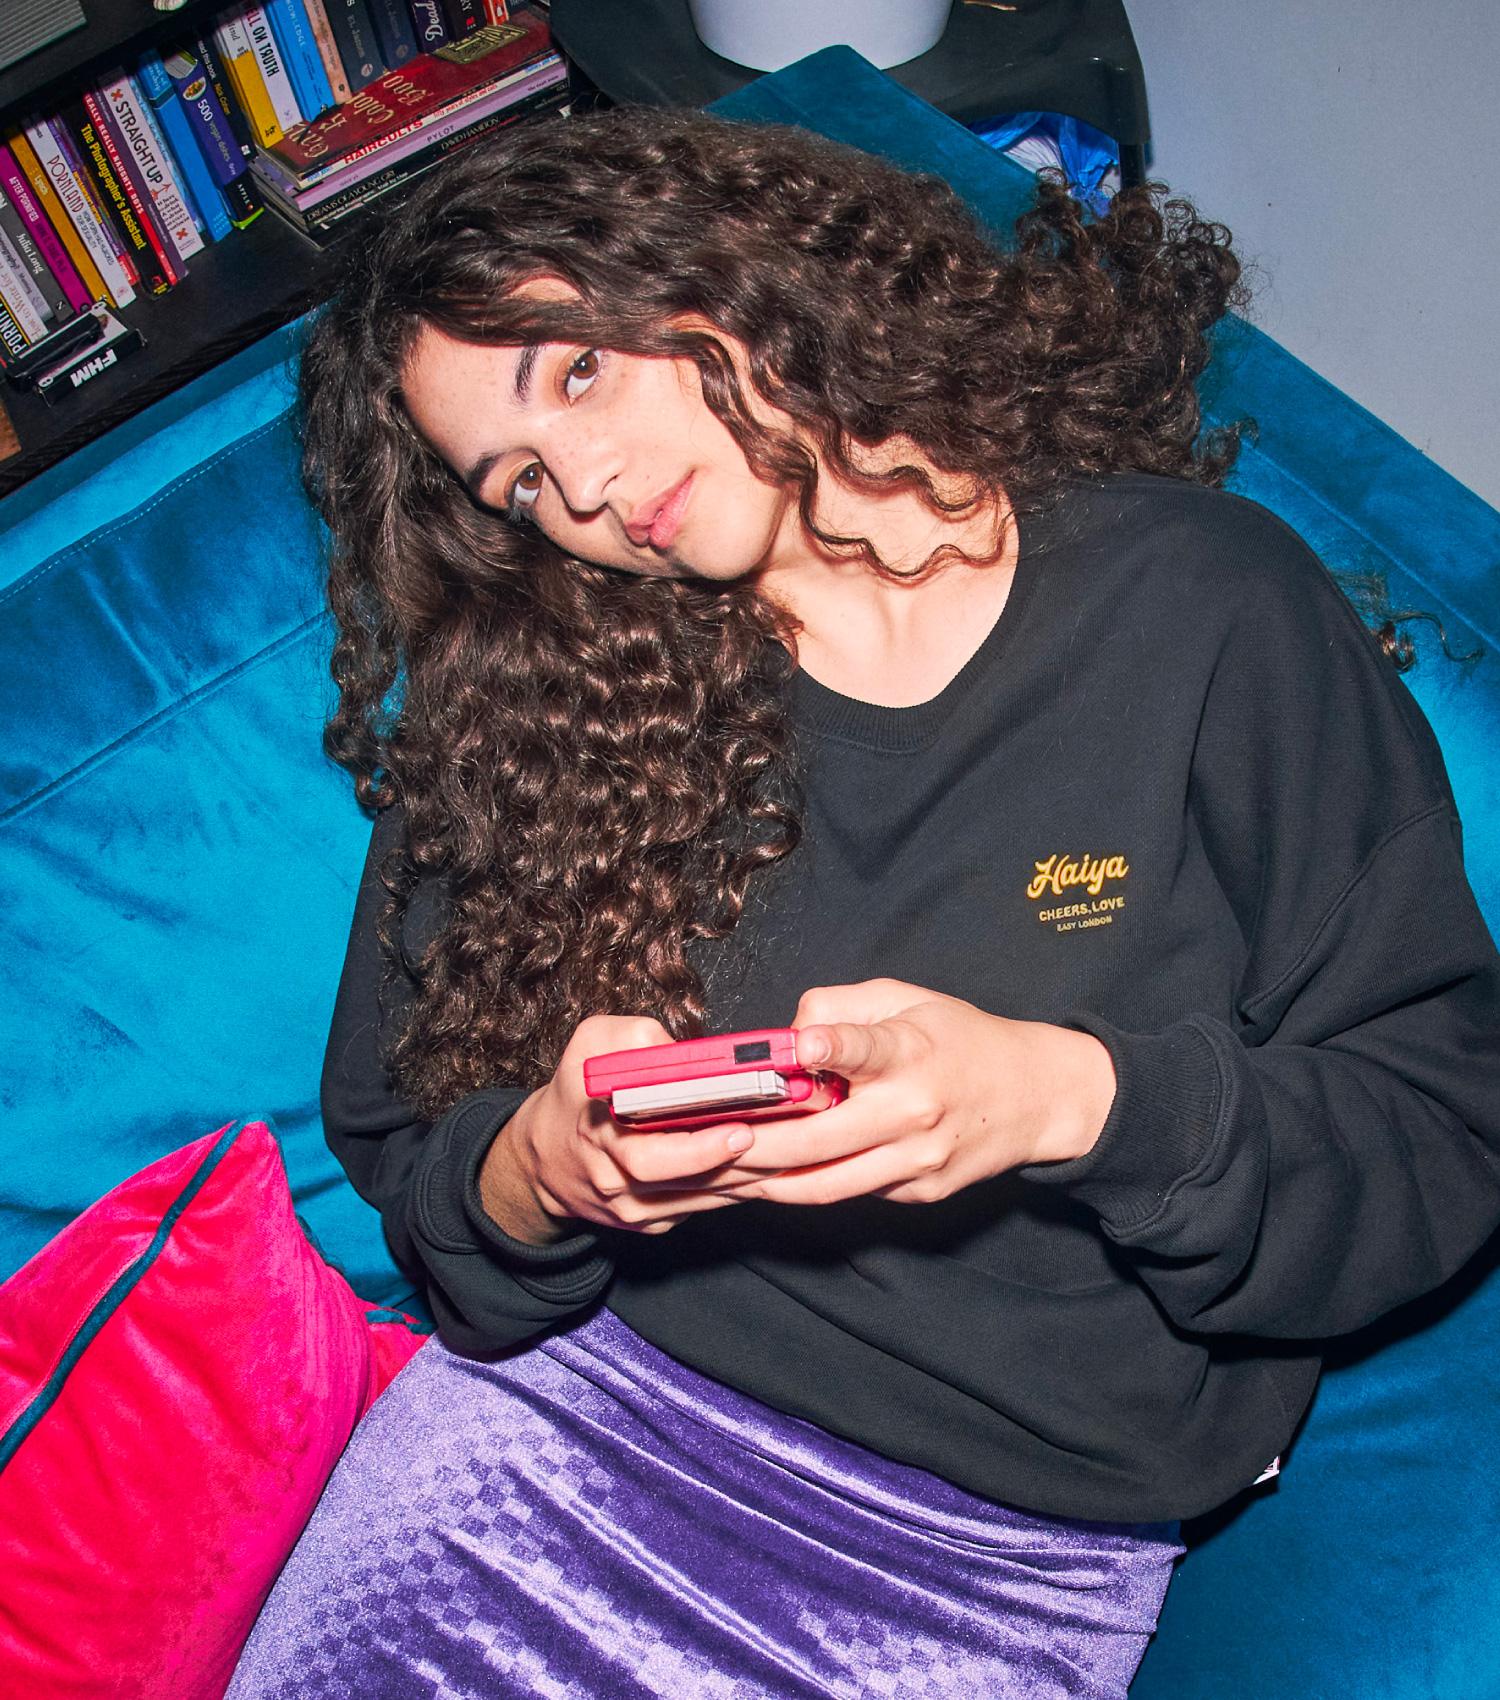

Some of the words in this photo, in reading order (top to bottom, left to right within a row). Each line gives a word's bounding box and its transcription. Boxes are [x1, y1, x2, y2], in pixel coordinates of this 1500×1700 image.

[80, 124, 96, 143] The
[112, 100, 158, 168] STRAIGHT
[144, 166, 163, 186] UP
[195, 98, 214, 121] 500
[206, 121, 222, 141] vegan
[216, 141, 232, 161] dishes
[343, 119, 424, 164] HAIRCULTS
[426, 124, 455, 142] PYLOT
[45, 155, 86, 213] PORNLAND
[84, 142, 129, 209] Photographer's
[96, 124, 117, 154] REALLY
[110, 155, 135, 191] NAUGHTY
[129, 193, 144, 214] DOTS
[305, 199, 338, 220] DREAMS
[440, 133, 464, 149] DAVID
[461, 116, 501, 139] HAMILTON
[8, 175, 24, 195] AFTER
[17, 192, 39, 221] PORNIFIED
[118, 207, 148, 249] Assistant
[15, 231, 33, 253] Julia
[26, 251, 45, 274] Long
[5, 285, 26, 312] Write
[67, 348, 120, 387] FHM
[1026, 854, 1129, 899] Haiya
[1039, 903, 1092, 922] CHEERS,
[1091, 896, 1126, 913] LOVE
[1078, 915, 1113, 929] LONDON
